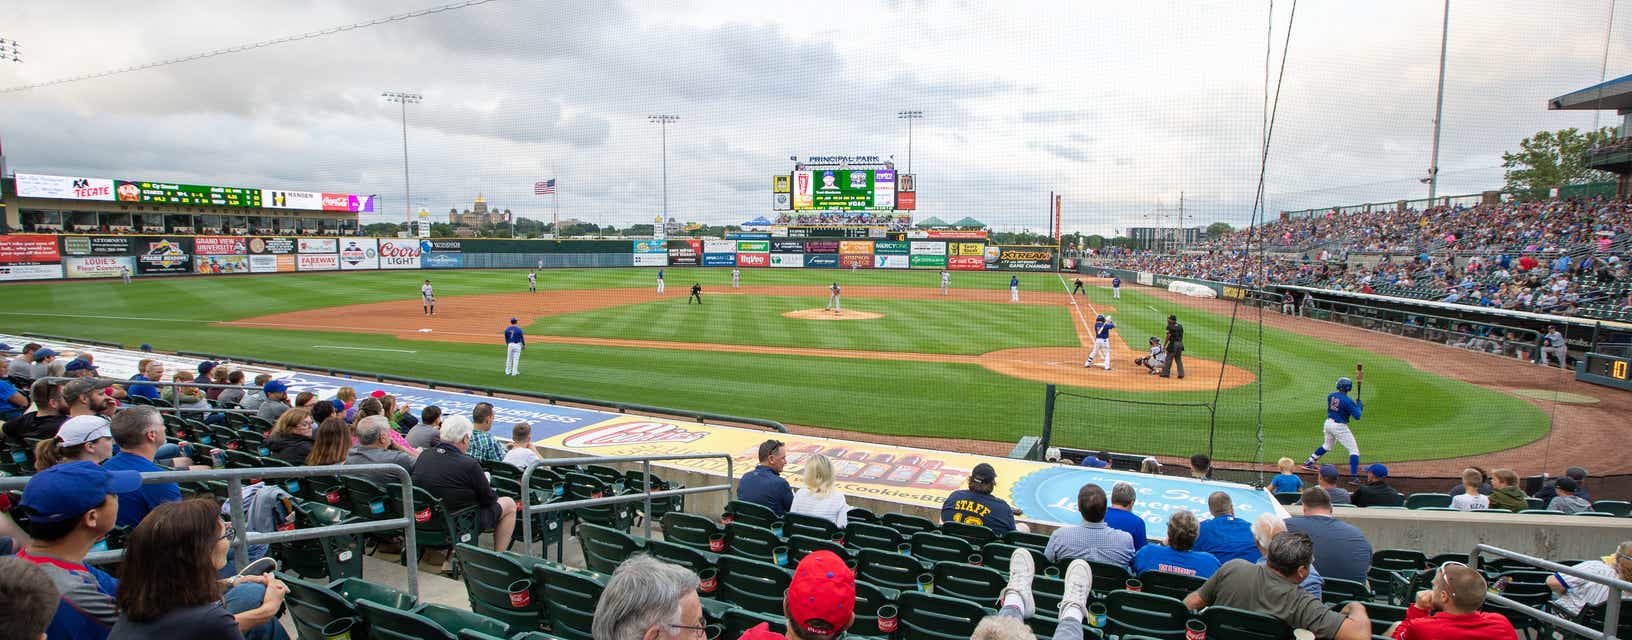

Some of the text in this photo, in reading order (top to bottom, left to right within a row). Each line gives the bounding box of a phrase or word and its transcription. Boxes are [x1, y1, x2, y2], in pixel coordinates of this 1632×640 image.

[74, 186, 110, 198] TECATE
[380, 241, 420, 258] Coors
[1001, 250, 1050, 261] XTREAM
[387, 257, 415, 265] LIGHT
[1612, 360, 1628, 380] 10
[954, 499, 991, 517] STAFF
